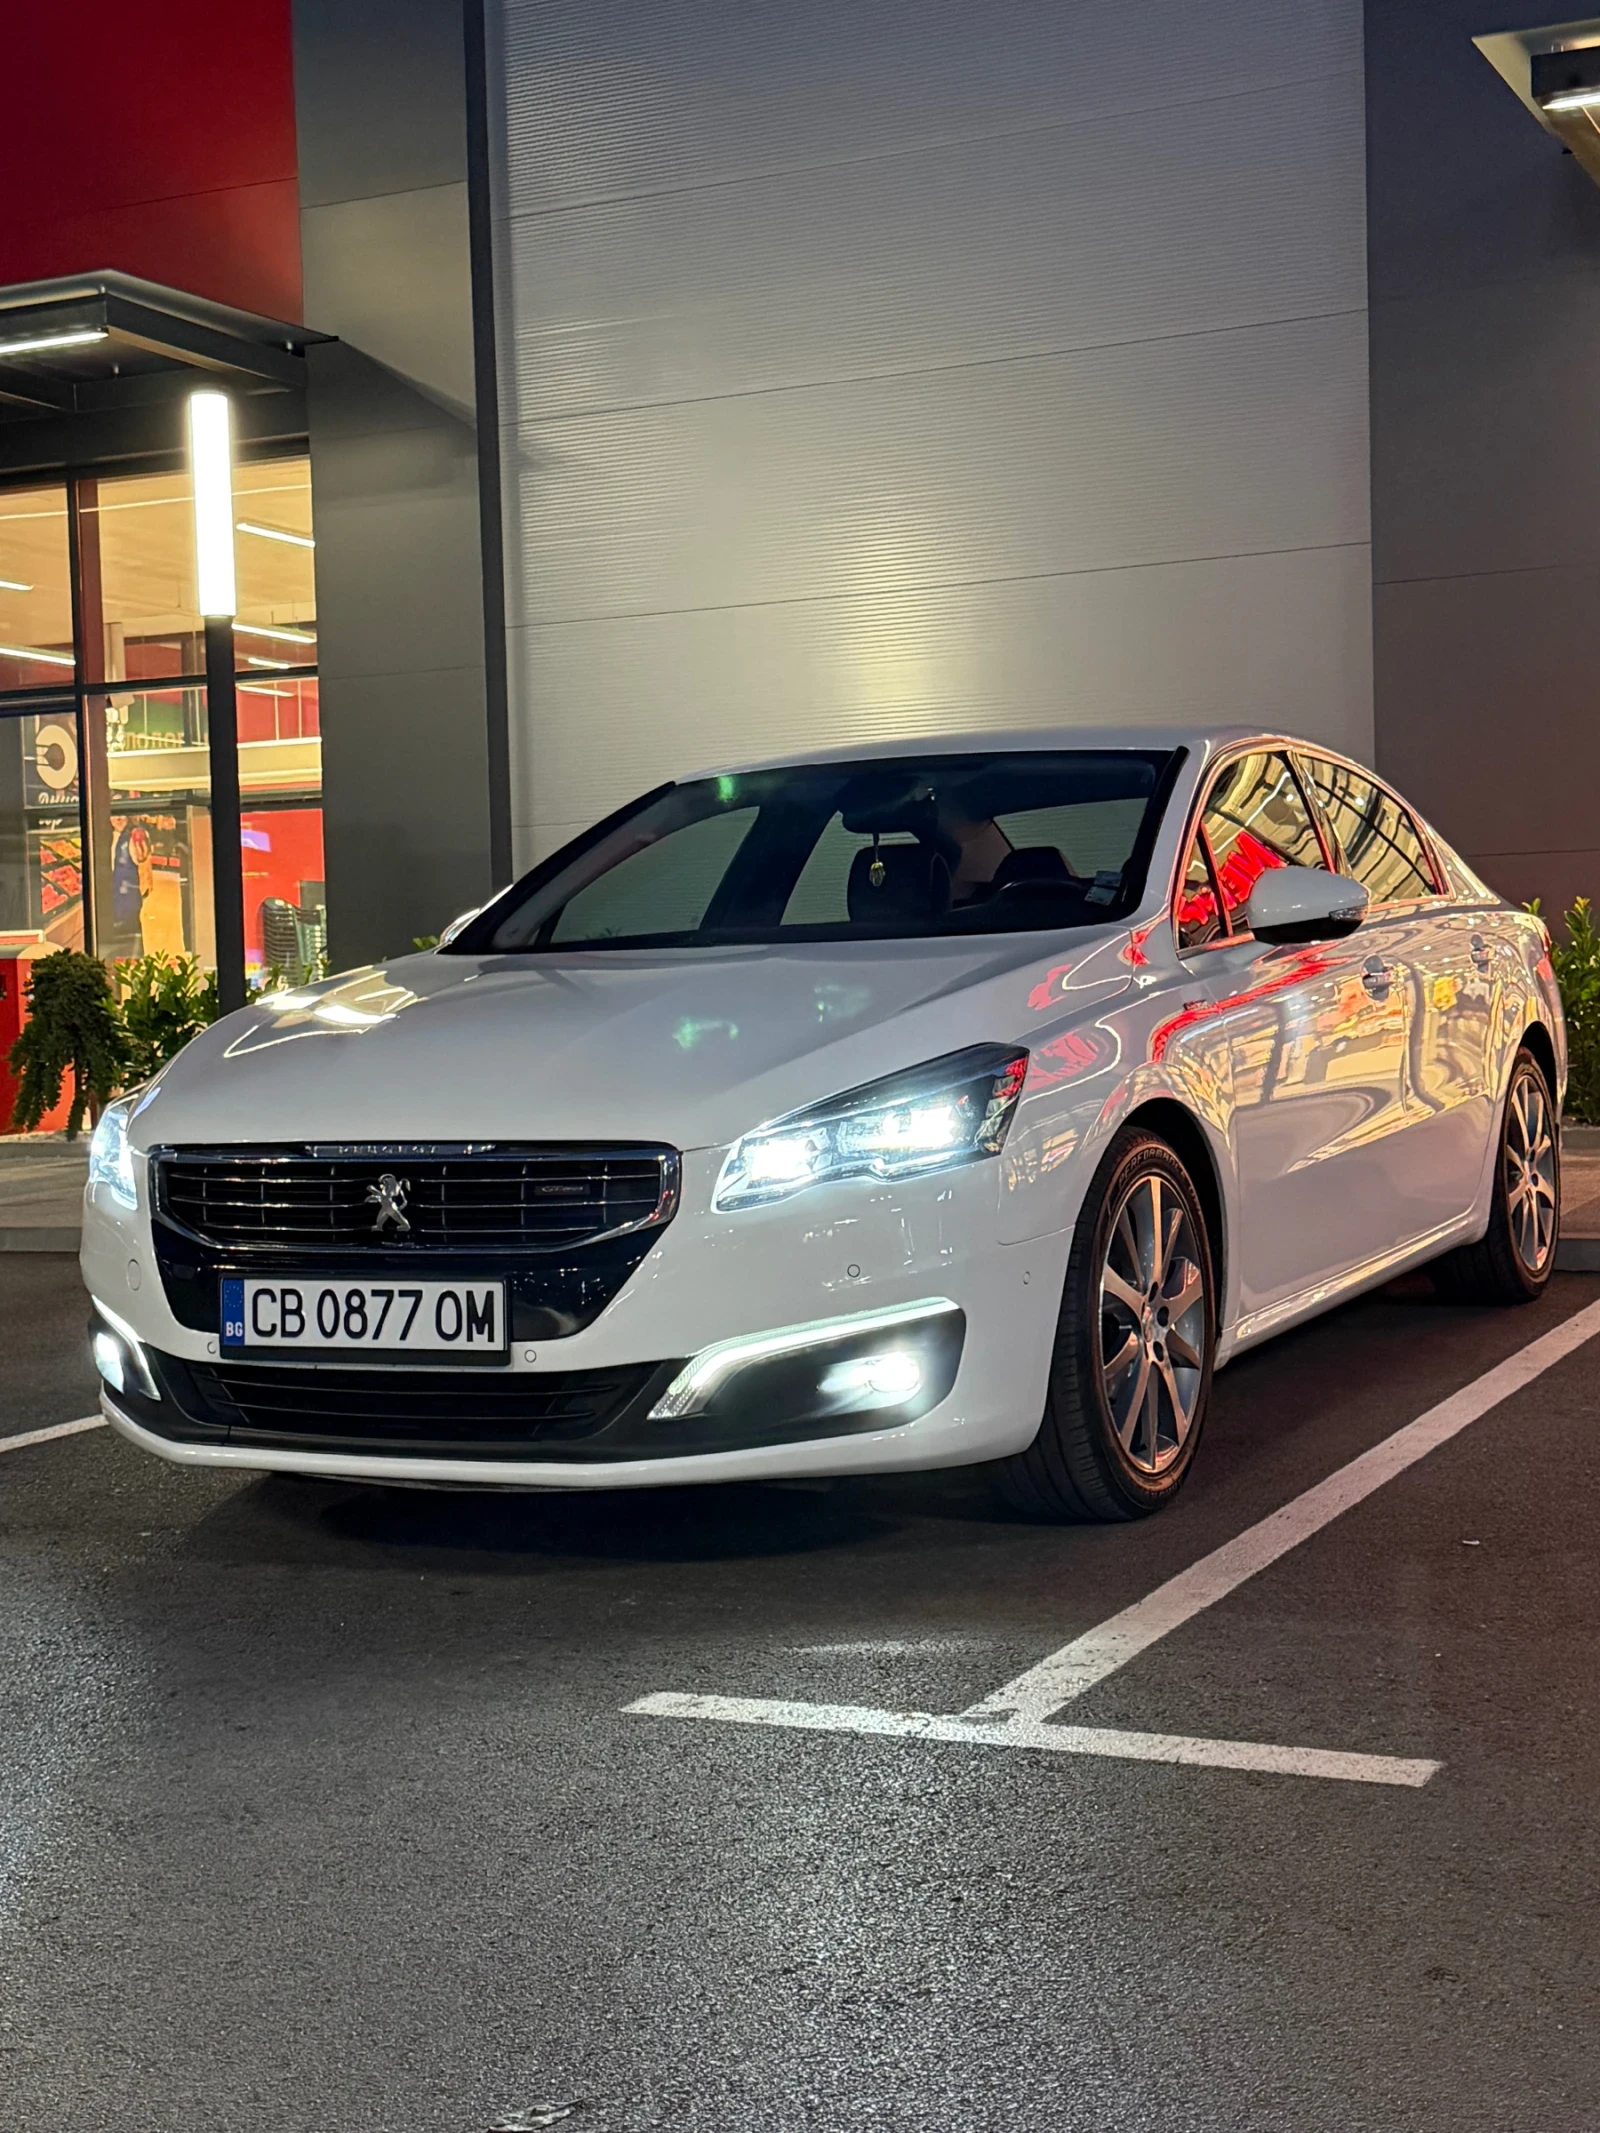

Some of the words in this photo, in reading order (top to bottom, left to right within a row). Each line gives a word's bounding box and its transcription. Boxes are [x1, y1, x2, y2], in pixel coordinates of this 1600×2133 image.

[225, 1321, 243, 1338] BG
[252, 1287, 306, 1338] CB
[316, 1288, 424, 1341] 0877
[434, 1290, 495, 1343] OM
